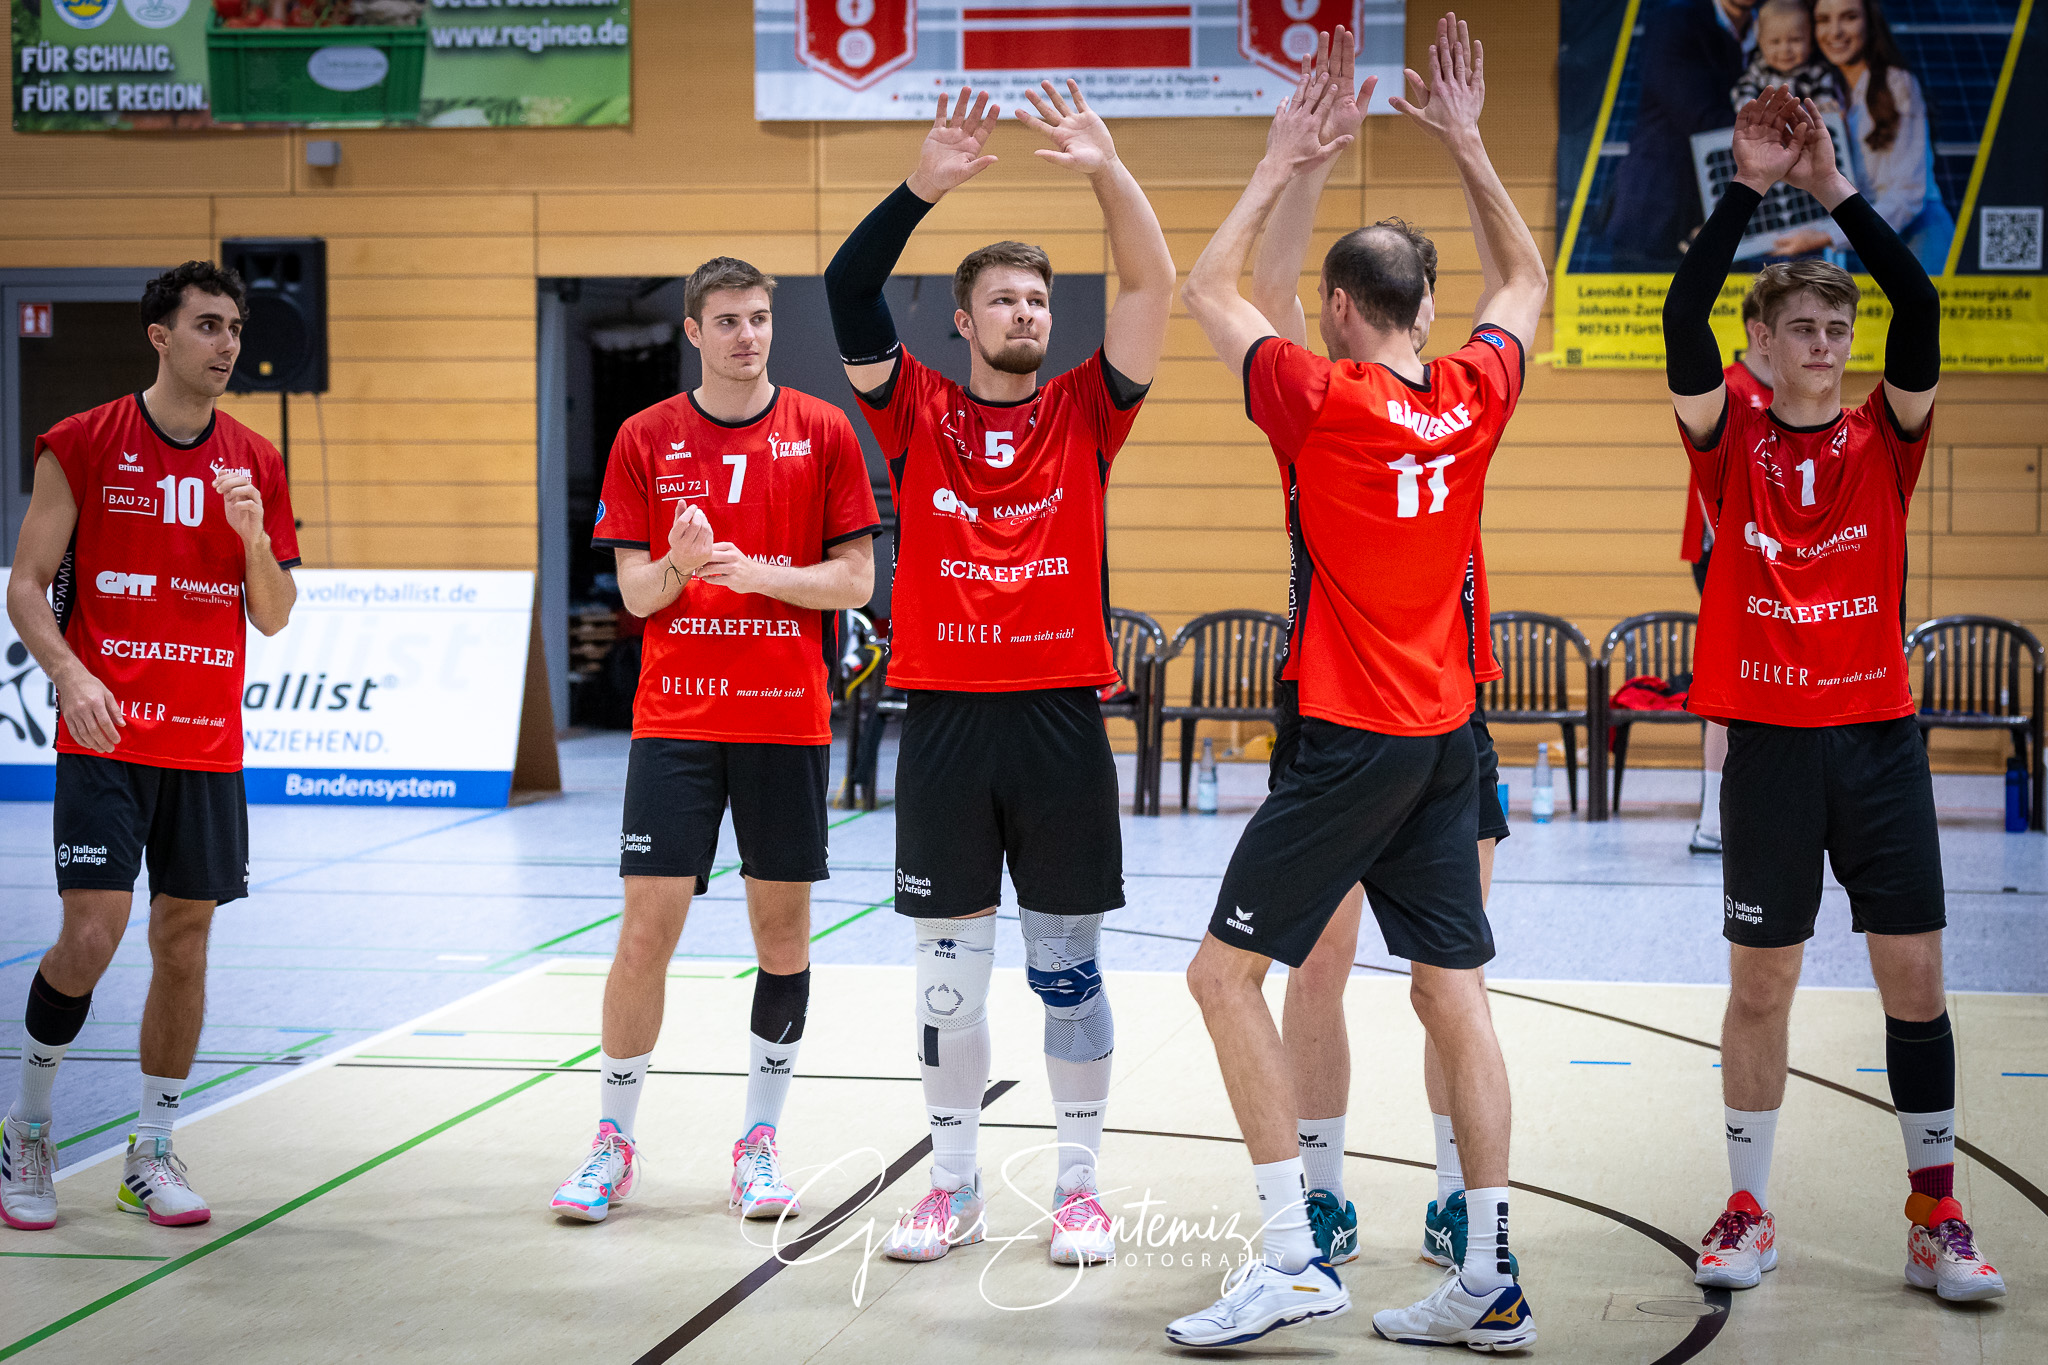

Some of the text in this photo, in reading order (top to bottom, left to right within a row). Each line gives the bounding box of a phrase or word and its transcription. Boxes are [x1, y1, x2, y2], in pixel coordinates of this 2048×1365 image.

[21, 40, 69, 72] FÜR
[21, 79, 210, 112] FÜR DIE REGION.
[665, 451, 692, 461] erima
[779, 441, 792, 451] TV
[984, 430, 1016, 469] 5
[118, 463, 144, 473] erima
[659, 480, 701, 494] BAU 72
[722, 454, 748, 504] 7
[1386, 453, 1456, 518] 11
[1795, 458, 1816, 507] 1
[109, 494, 151, 508] BAU 72
[156, 474, 205, 528] 10
[1796, 524, 1868, 559] KAMMACHI
[940, 557, 1070, 583] SCHAEFFLER
[95, 570, 157, 597] GMT
[170, 577, 240, 597] KAMMACHI
[183, 592, 232, 608] Consulting
[1746, 595, 1879, 625] SCHAEFFLER
[668, 617, 802, 637] SCHAEFFLER
[937, 622, 1076, 644] DELKER man sieht sich!
[100, 638, 235, 668] SCHAEFFLER
[1740, 659, 1888, 687] DELKER man sieht sich!
[662, 676, 806, 698] DELKER man sieht sich!
[120, 700, 167, 721] LKER
[171, 714, 191, 724] man
[244, 728, 390, 754] NZIEHEND.
[285, 772, 457, 803] Bandensystem
[72, 844, 108, 855] Hallasch
[72, 854, 108, 866] Aufzüge
[904, 873, 931, 887] Hallasch
[904, 883, 932, 897] Aufzüge
[1226, 917, 1254, 935] erima
[934, 949, 957, 961] errea
[28, 1058, 56, 1068] erima
[760, 1065, 791, 1075] erima
[606, 1078, 637, 1086] erima
[930, 1119, 962, 1127] erima
[1064, 1110, 1098, 1119] erima
[1922, 1134, 1953, 1145] erima
